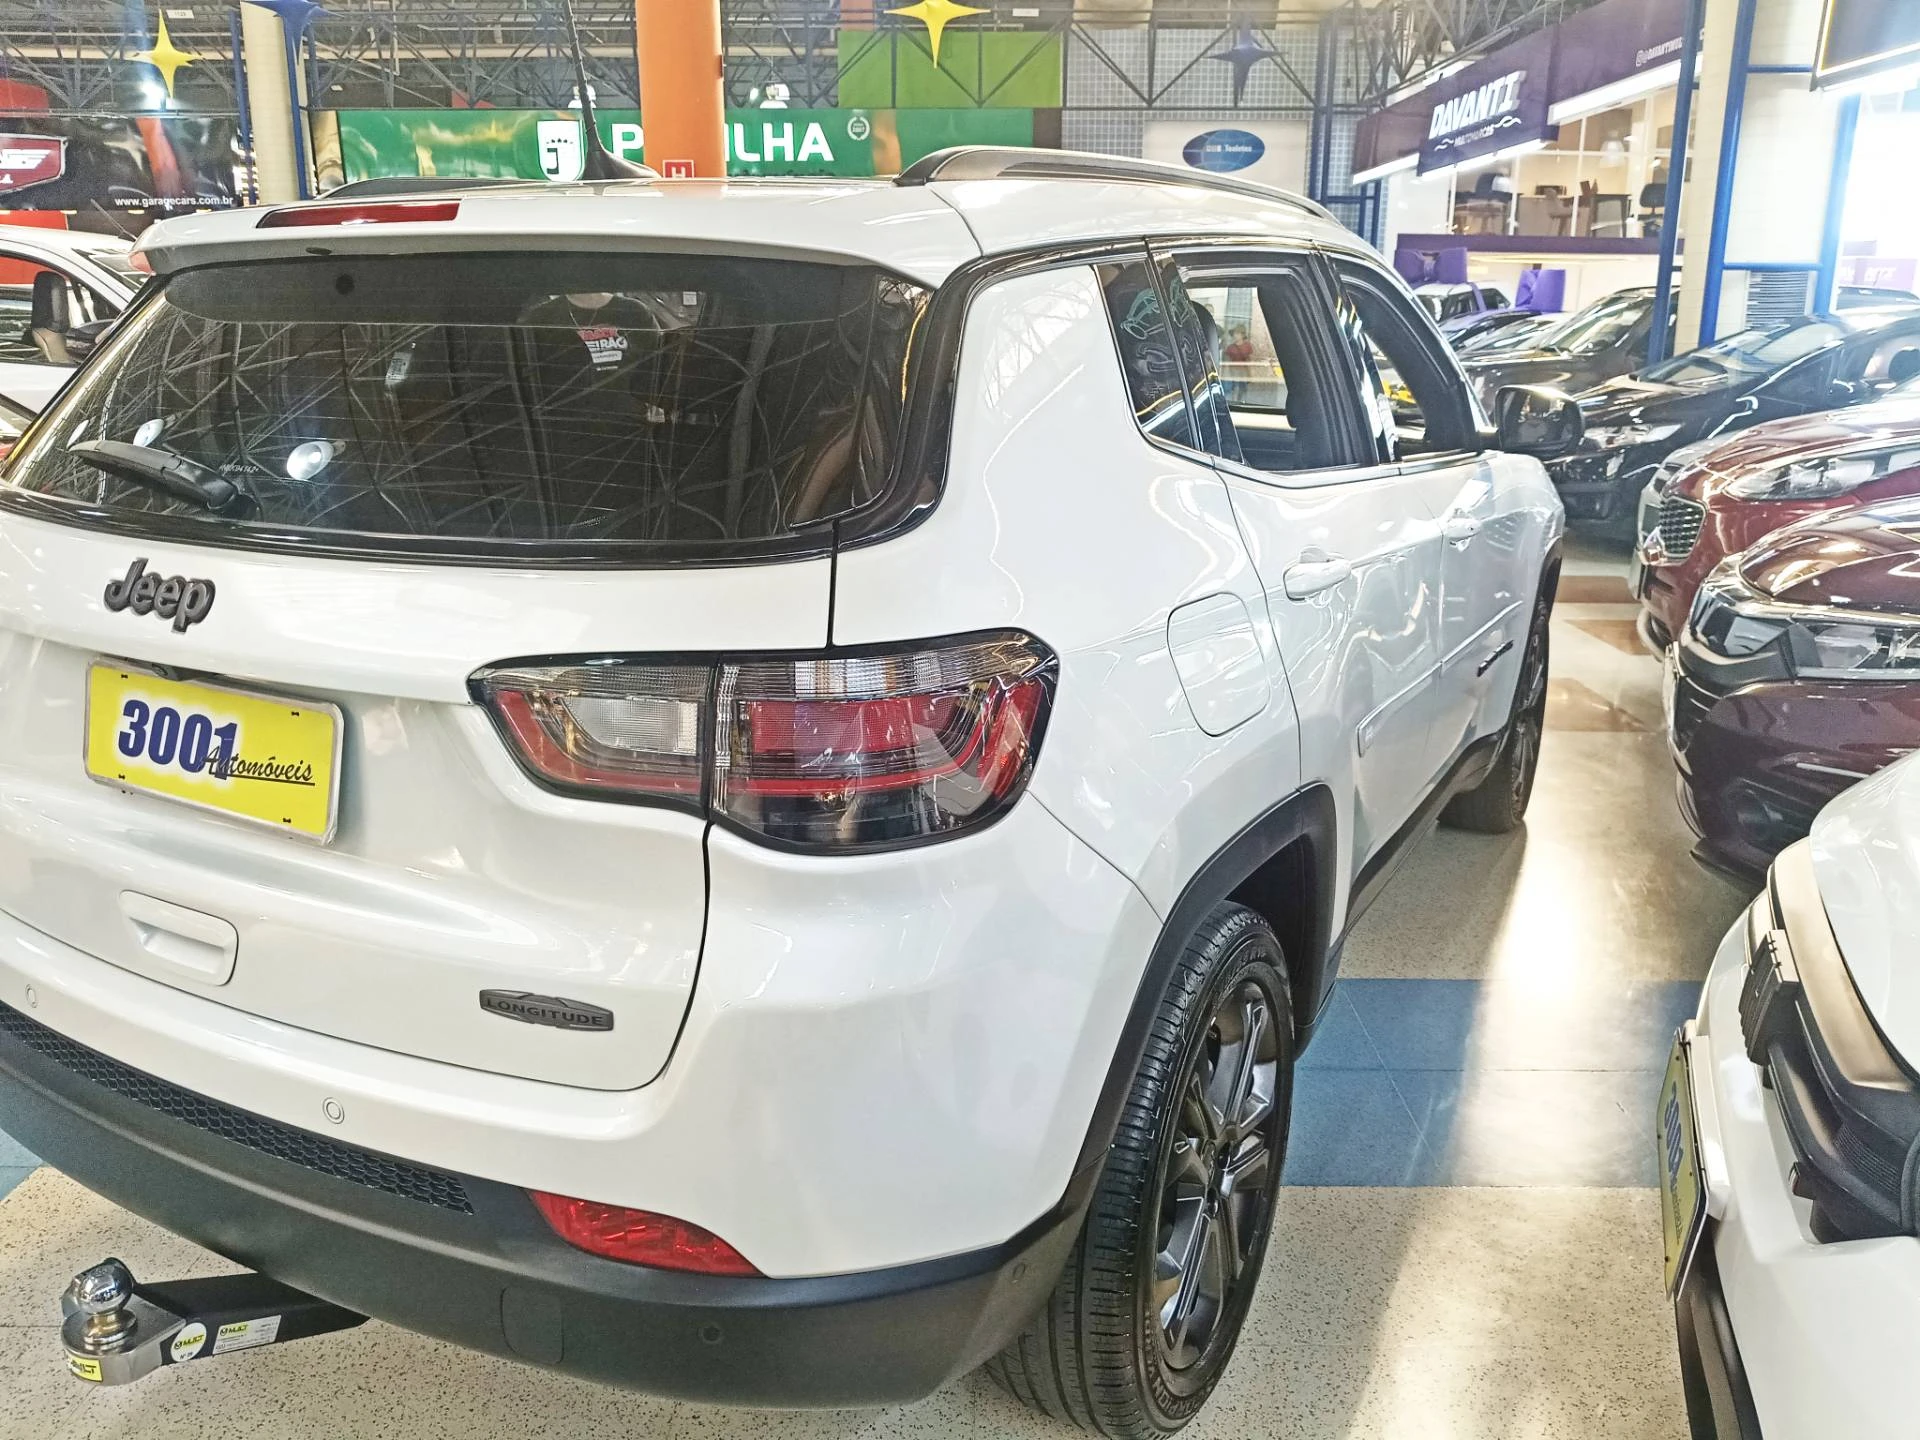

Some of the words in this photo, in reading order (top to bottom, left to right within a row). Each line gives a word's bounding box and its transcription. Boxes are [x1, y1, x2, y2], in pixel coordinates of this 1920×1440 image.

[1428, 70, 1526, 140] DAVANTI
[114, 195, 234, 209] www.garagecars.com.br
[104, 557, 216, 634] Jeep
[118, 699, 238, 781] 3001
[202, 746, 315, 783] Automóveis
[485, 998, 603, 1026] LONGITUDE
